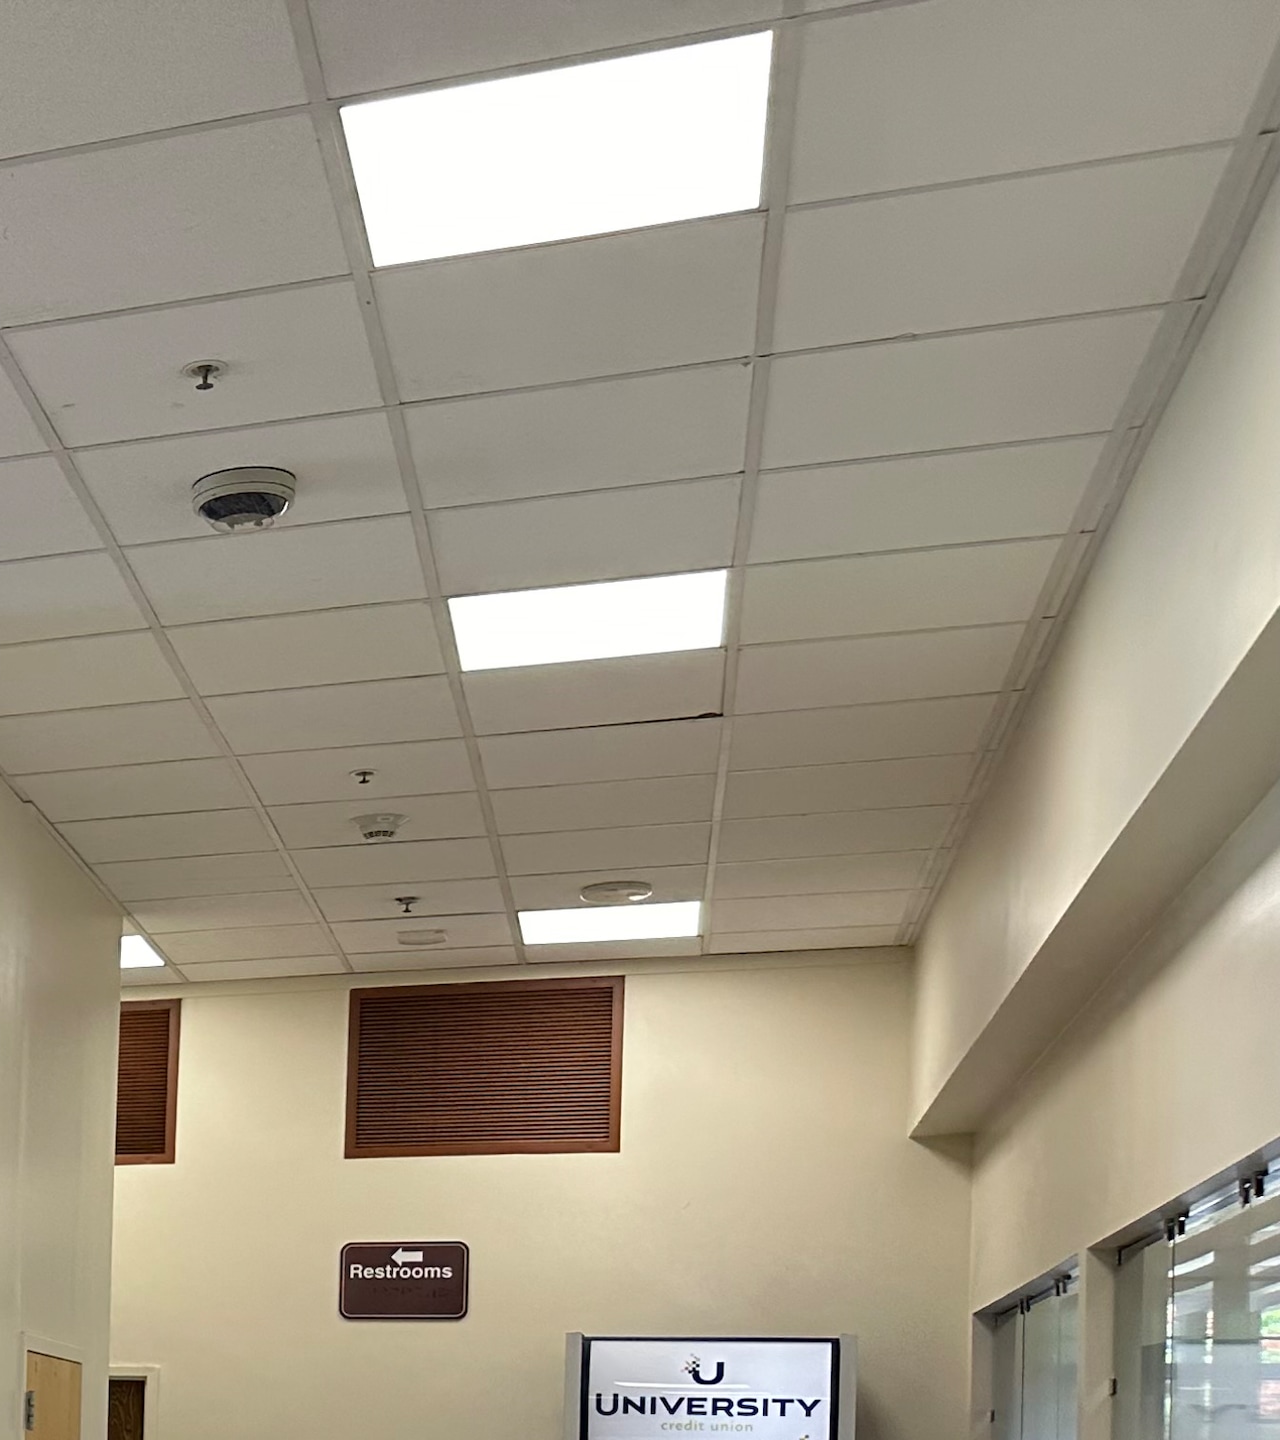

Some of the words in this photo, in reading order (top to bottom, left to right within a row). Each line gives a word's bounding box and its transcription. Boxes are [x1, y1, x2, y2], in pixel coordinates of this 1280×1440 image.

[349, 1263, 453, 1279] Restrooms
[595, 1393, 821, 1417] UNIVERSITY
[660, 1420, 705, 1431] credit
[710, 1421, 753, 1432] union
